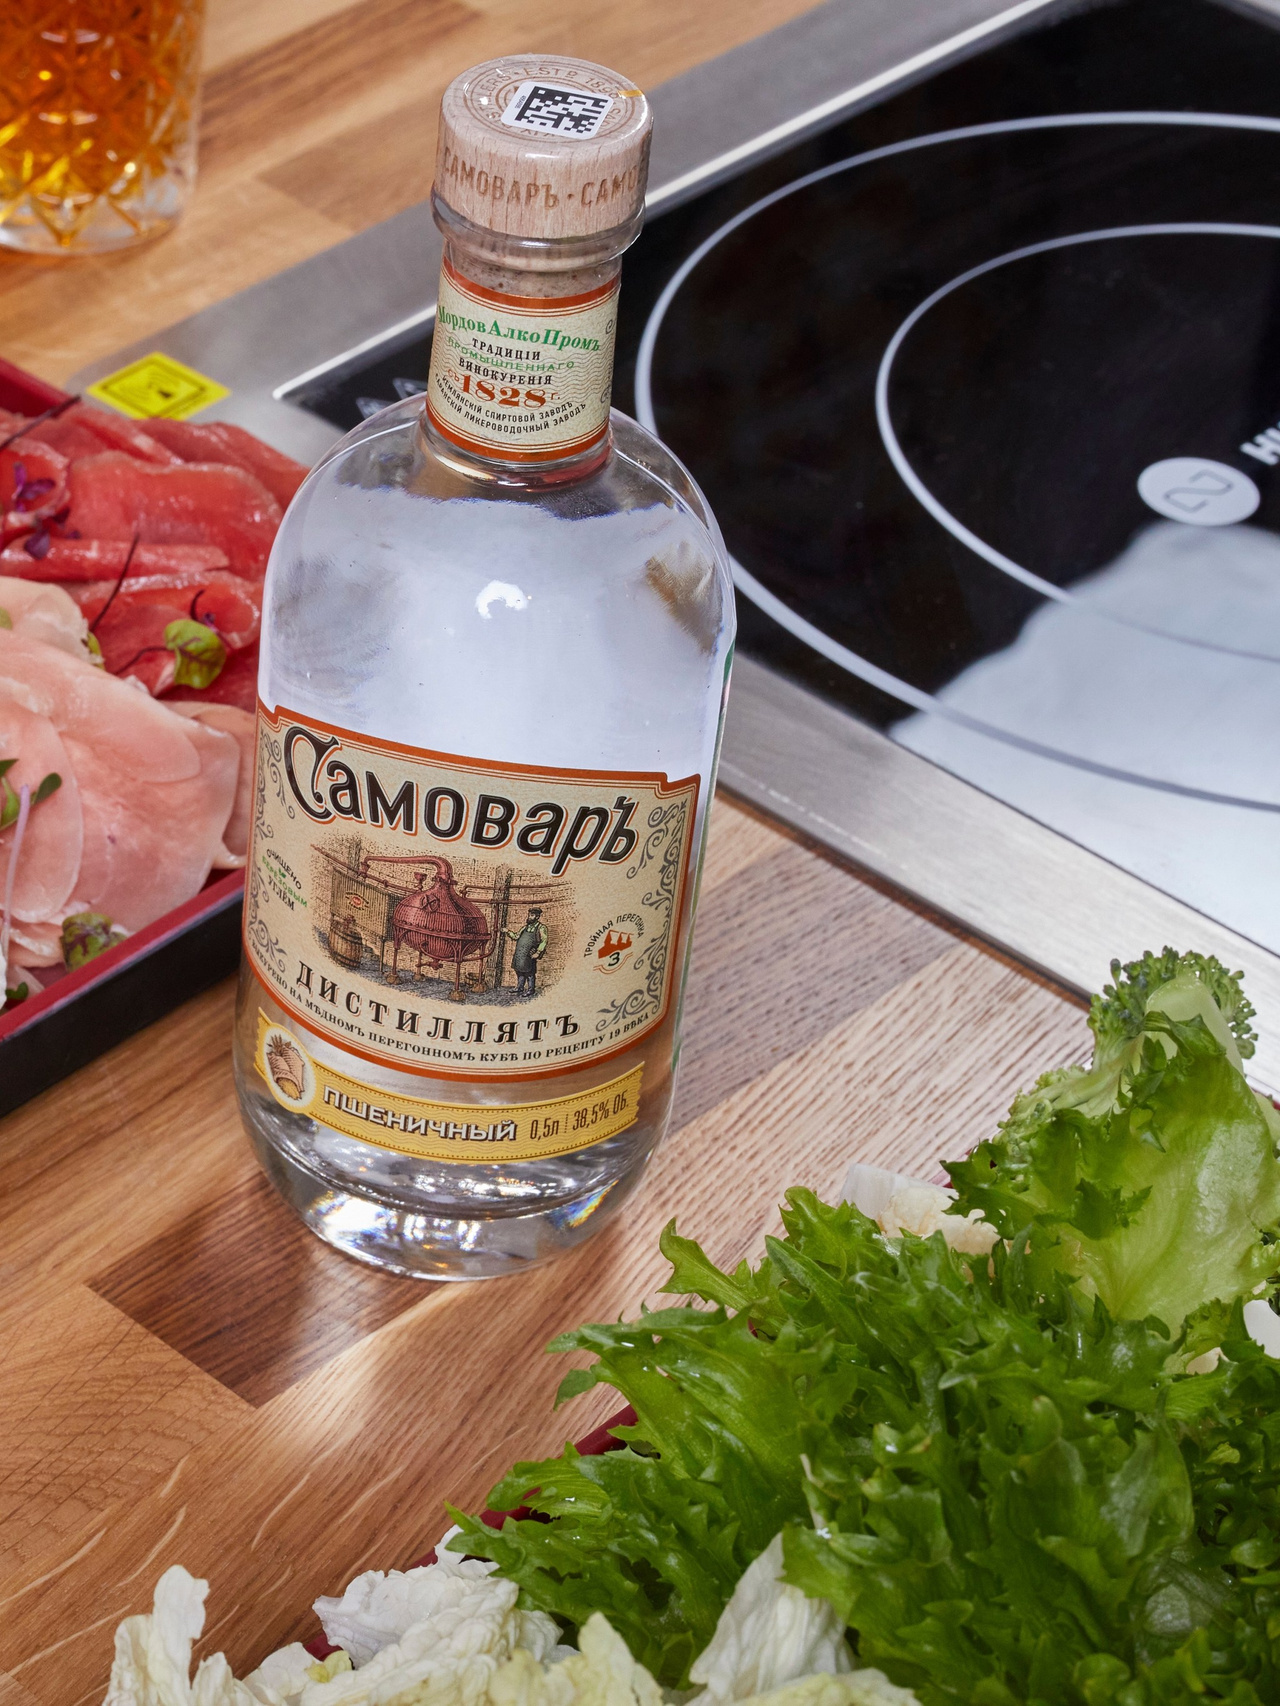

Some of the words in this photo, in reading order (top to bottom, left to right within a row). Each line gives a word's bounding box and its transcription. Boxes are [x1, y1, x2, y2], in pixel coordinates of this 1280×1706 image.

[443, 146, 560, 211] САМОВАРЪ
[462, 374, 547, 409] 1828
[463, 410, 551, 436] ЛИКЕРОВОДОЧНЫЙ
[552, 403, 588, 427] ЗАВОДЪ
[484, 408, 537, 424] СПИРТОВОЙ
[538, 400, 574, 421] ЗАВОДЪ
[282, 724, 640, 878] Самоваръ
[583, 919, 615, 959] ТРОЙНАЯ
[607, 951, 621, 967] 3
[296, 961, 580, 1044] ДИСТИЛЛЯТЪ
[367, 1030, 477, 1063] ПЕРЕГОННОМЪ
[522, 1048, 543, 1062] ПО
[545, 1035, 608, 1059] РЕЦЕПТУ
[608, 1027, 622, 1041] 19
[322, 1083, 519, 1144] ПШЕНИЧНЫЙ
[572, 1098, 611, 1131] 38,5%
